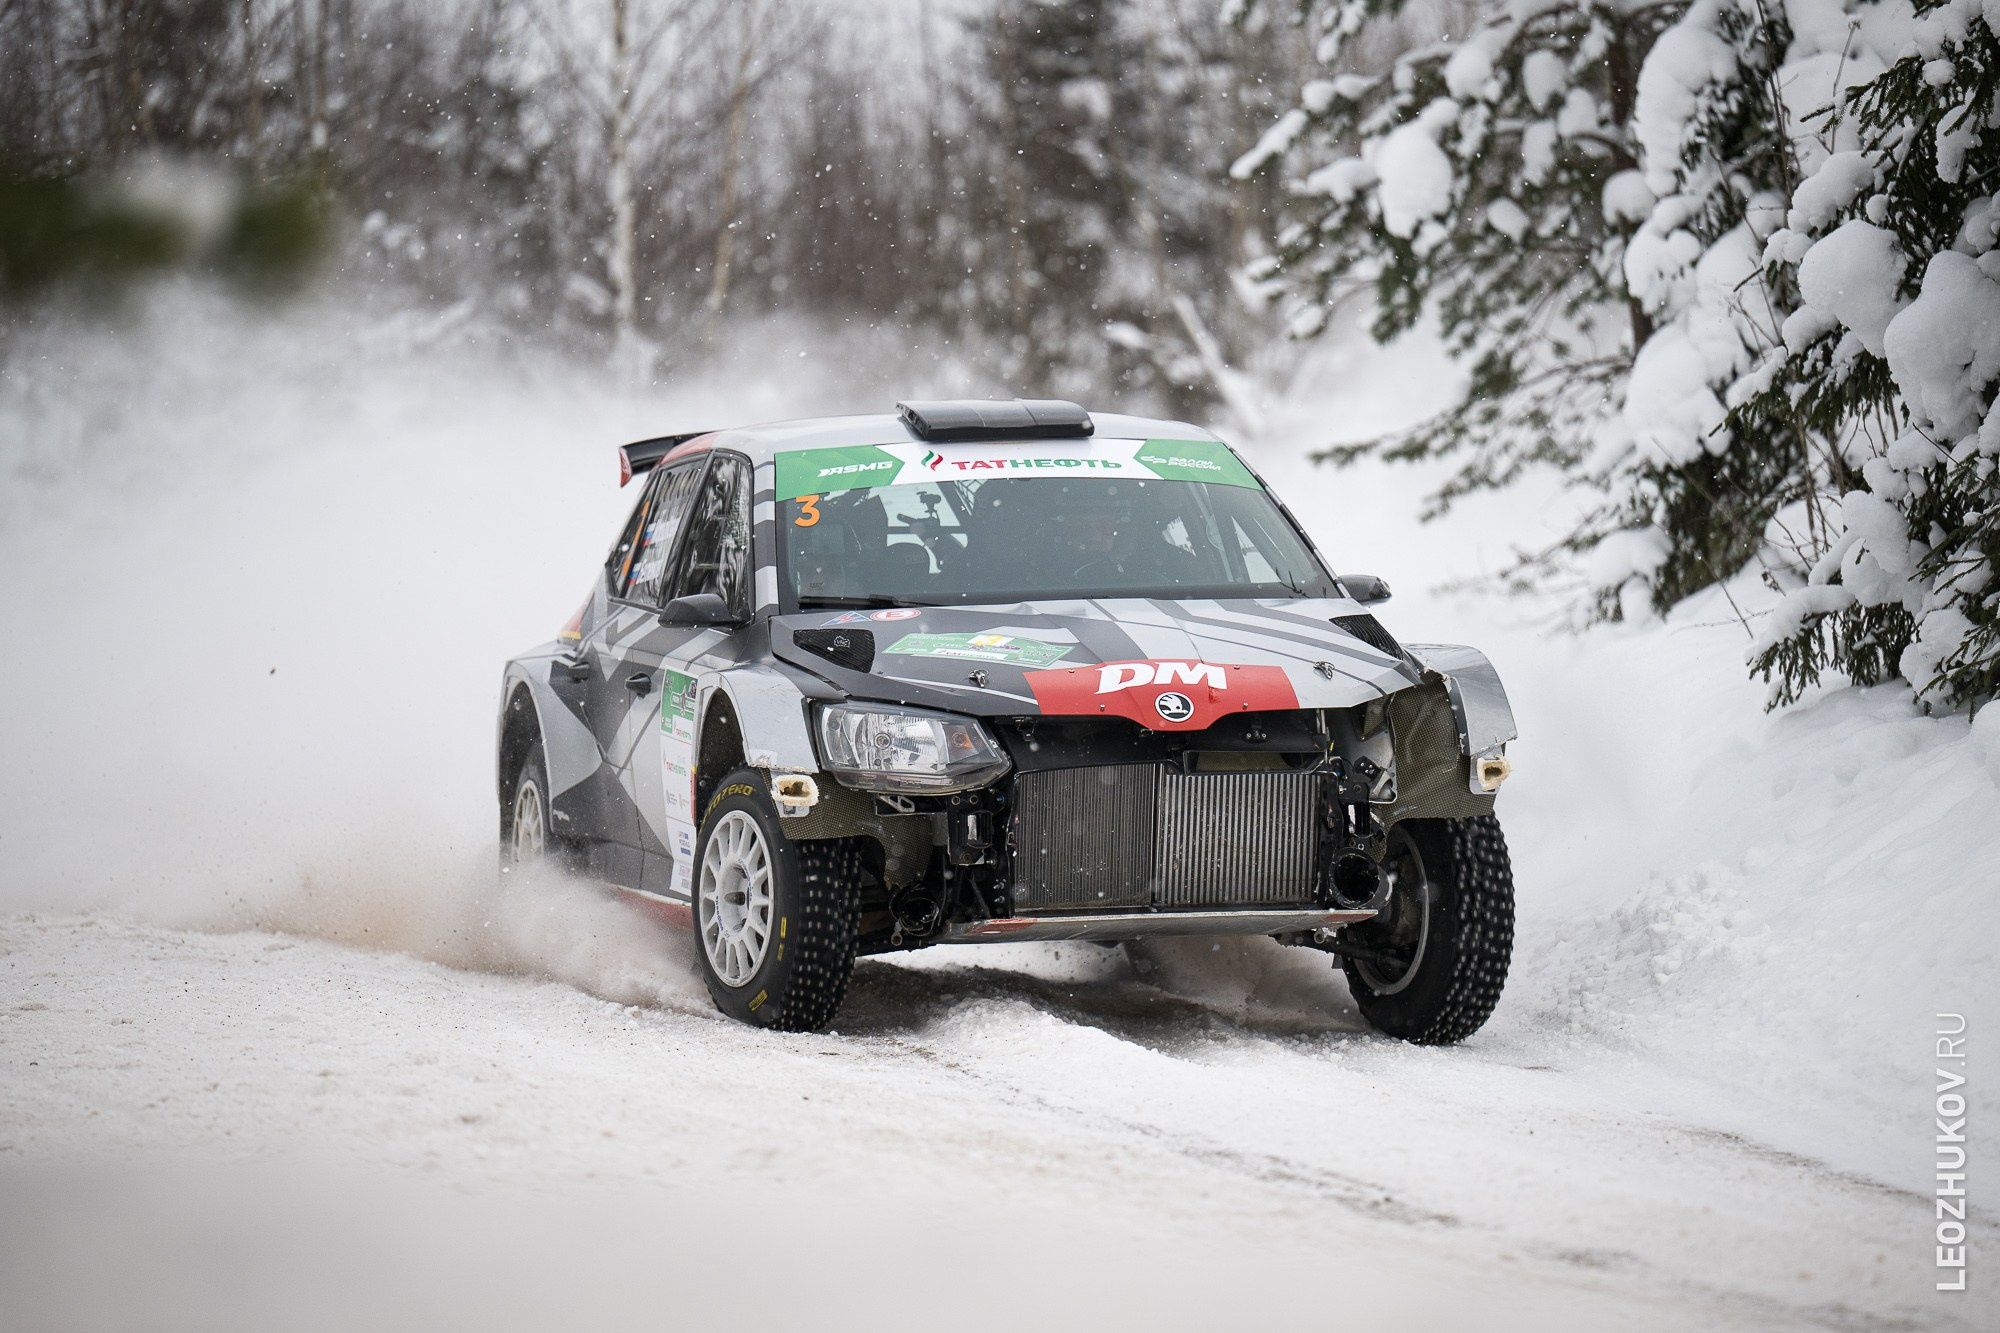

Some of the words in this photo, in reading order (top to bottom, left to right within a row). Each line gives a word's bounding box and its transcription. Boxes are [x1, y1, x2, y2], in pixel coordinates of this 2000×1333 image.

[951, 459, 1123, 470] ТАТНЕФТЬ
[794, 495, 820, 527] 3
[1094, 662, 1228, 695] DM
